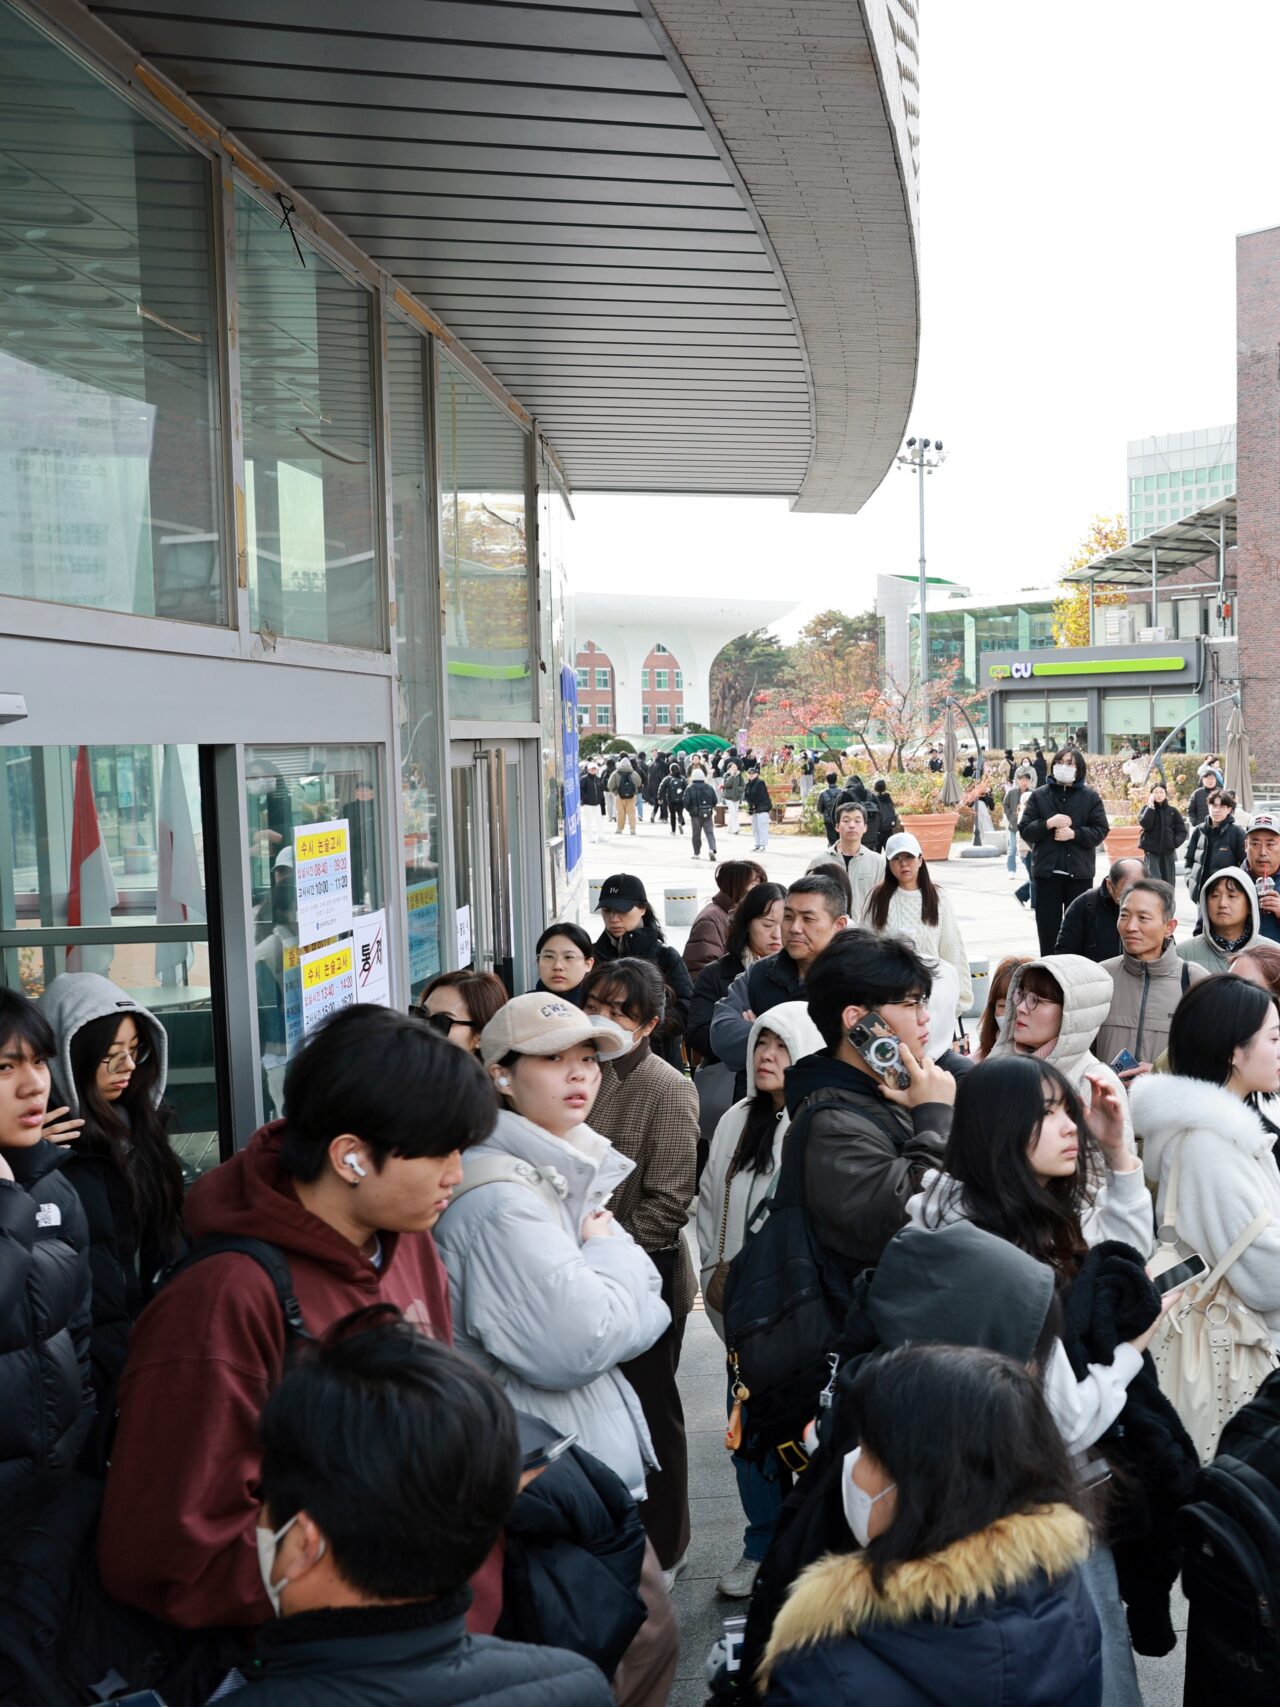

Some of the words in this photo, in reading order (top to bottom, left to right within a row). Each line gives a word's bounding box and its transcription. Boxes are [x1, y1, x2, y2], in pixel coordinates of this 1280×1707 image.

[1012, 662, 1032, 679] CU
[301, 839, 314, 857] 수시
[317, 834, 342, 854] 논술고사
[298, 883, 315, 898] 고사시간
[315, 879, 328, 895] 10:00
[335, 874, 348, 890] 11:20
[308, 965, 321, 984] 수시
[324, 954, 348, 977] 논술고사
[321, 984, 335, 1000] 13:40
[340, 975, 353, 991] 14:20
